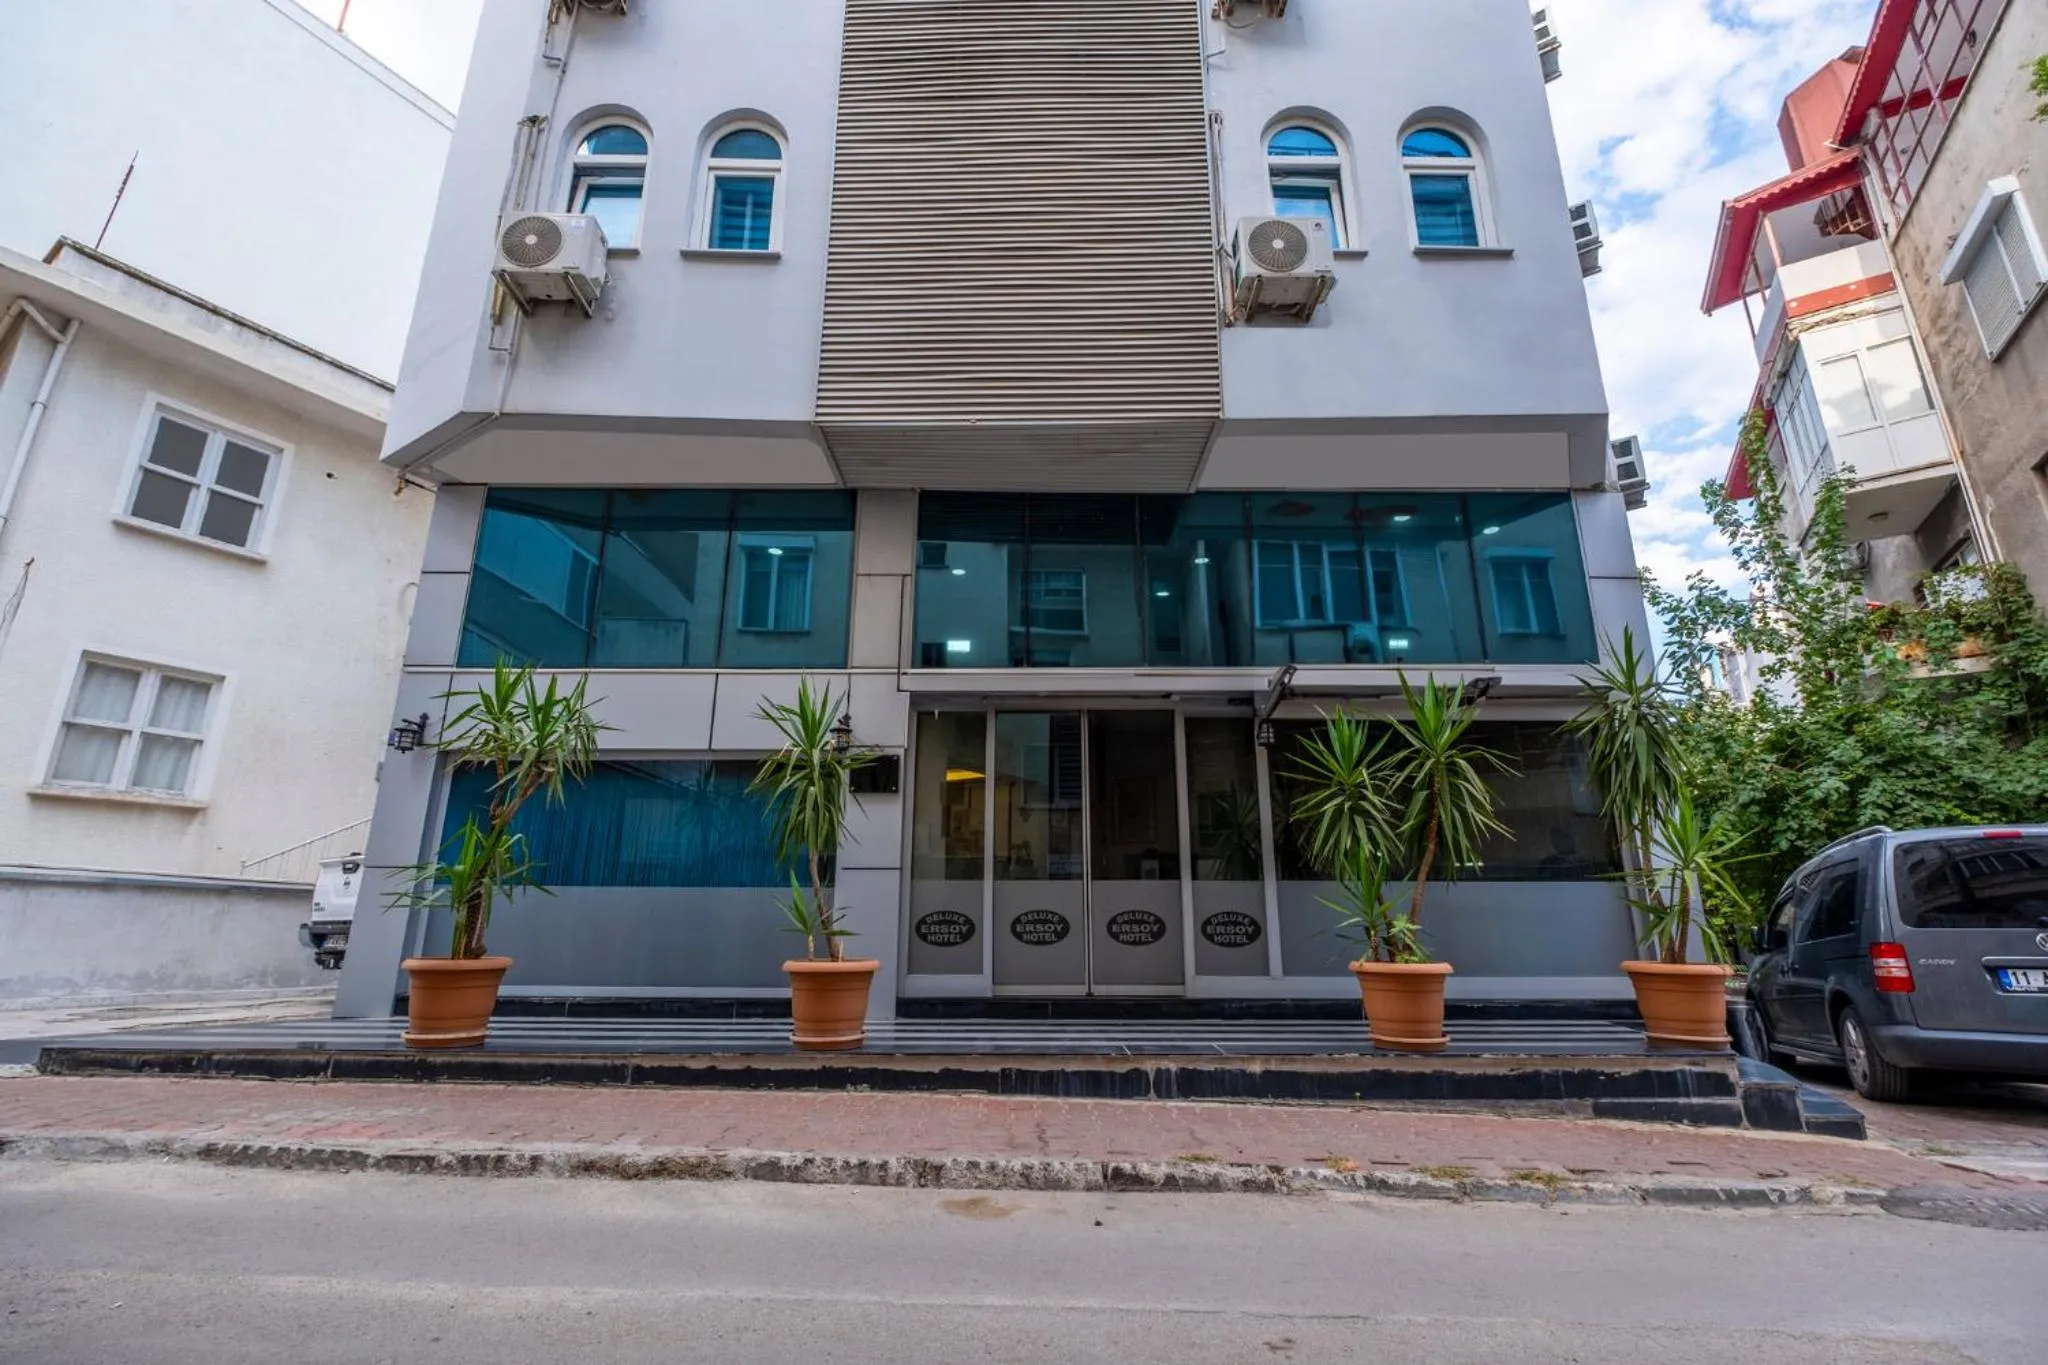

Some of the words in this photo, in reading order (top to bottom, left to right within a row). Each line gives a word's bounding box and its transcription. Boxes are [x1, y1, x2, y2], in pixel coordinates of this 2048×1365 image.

[925, 911, 967, 923] DELUXE
[1020, 911, 1060, 923] DELUXE
[1116, 911, 1156, 923] DELUXE
[1211, 913, 1252, 925] DELUXE
[920, 924, 970, 933] ERSOY
[1016, 923, 1065, 932] ERSOY
[1112, 923, 1160, 932] ERSOY
[1206, 925, 1255, 934] ERSOY
[927, 933, 962, 943] HOTEL
[1022, 932, 1058, 941] HOTEL
[1119, 932, 1154, 941] HOTEL
[1214, 934, 1249, 943] HOTEL
